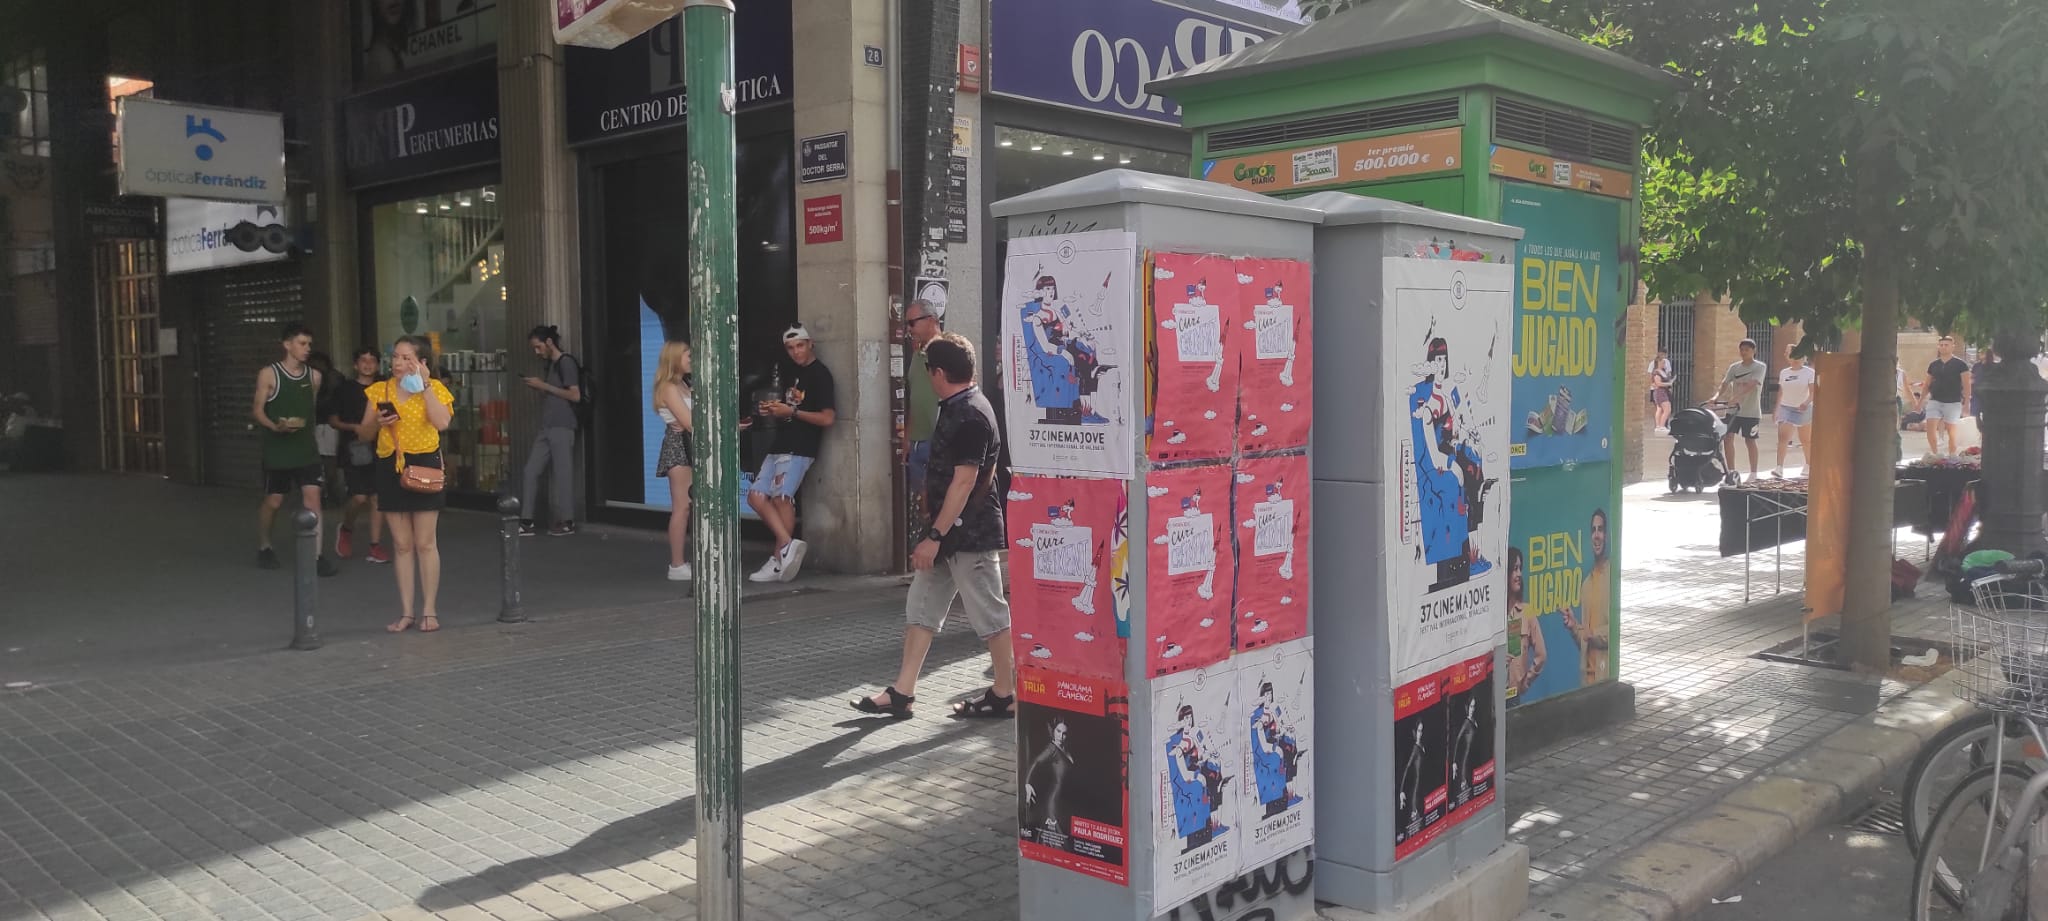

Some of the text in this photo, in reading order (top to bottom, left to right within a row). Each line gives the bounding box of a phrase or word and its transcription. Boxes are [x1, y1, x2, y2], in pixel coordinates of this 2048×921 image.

[411, 24, 463, 56] CHANEL
[868, 49, 880, 62] 28
[601, 101, 662, 131] CENTRO
[667, 94, 688, 118] DE
[395, 103, 498, 158] PERFUMERIAS
[1382, 143, 1415, 156] premio
[802, 162, 845, 176] DOCTOR SERRA
[1354, 153, 1431, 172] 500.000 €
[1251, 176, 1276, 185] DIARIO
[1544, 245, 1553, 257] LOS
[1522, 257, 1600, 313] BIEN
[1512, 314, 1597, 377] JUGADO
[1029, 430, 1040, 441] 37
[1511, 445, 1525, 454] ONCE
[1528, 529, 1583, 573] BIEN
[1523, 566, 1583, 619] JUGADO
[1420, 602, 1432, 623] 37
[1057, 681, 1092, 694] PANORAMA
[1057, 690, 1093, 703] FLAMENCO
[1074, 826, 1092, 837] PAULA
[1255, 827, 1263, 839] 37
[1173, 861, 1182, 874] 37
